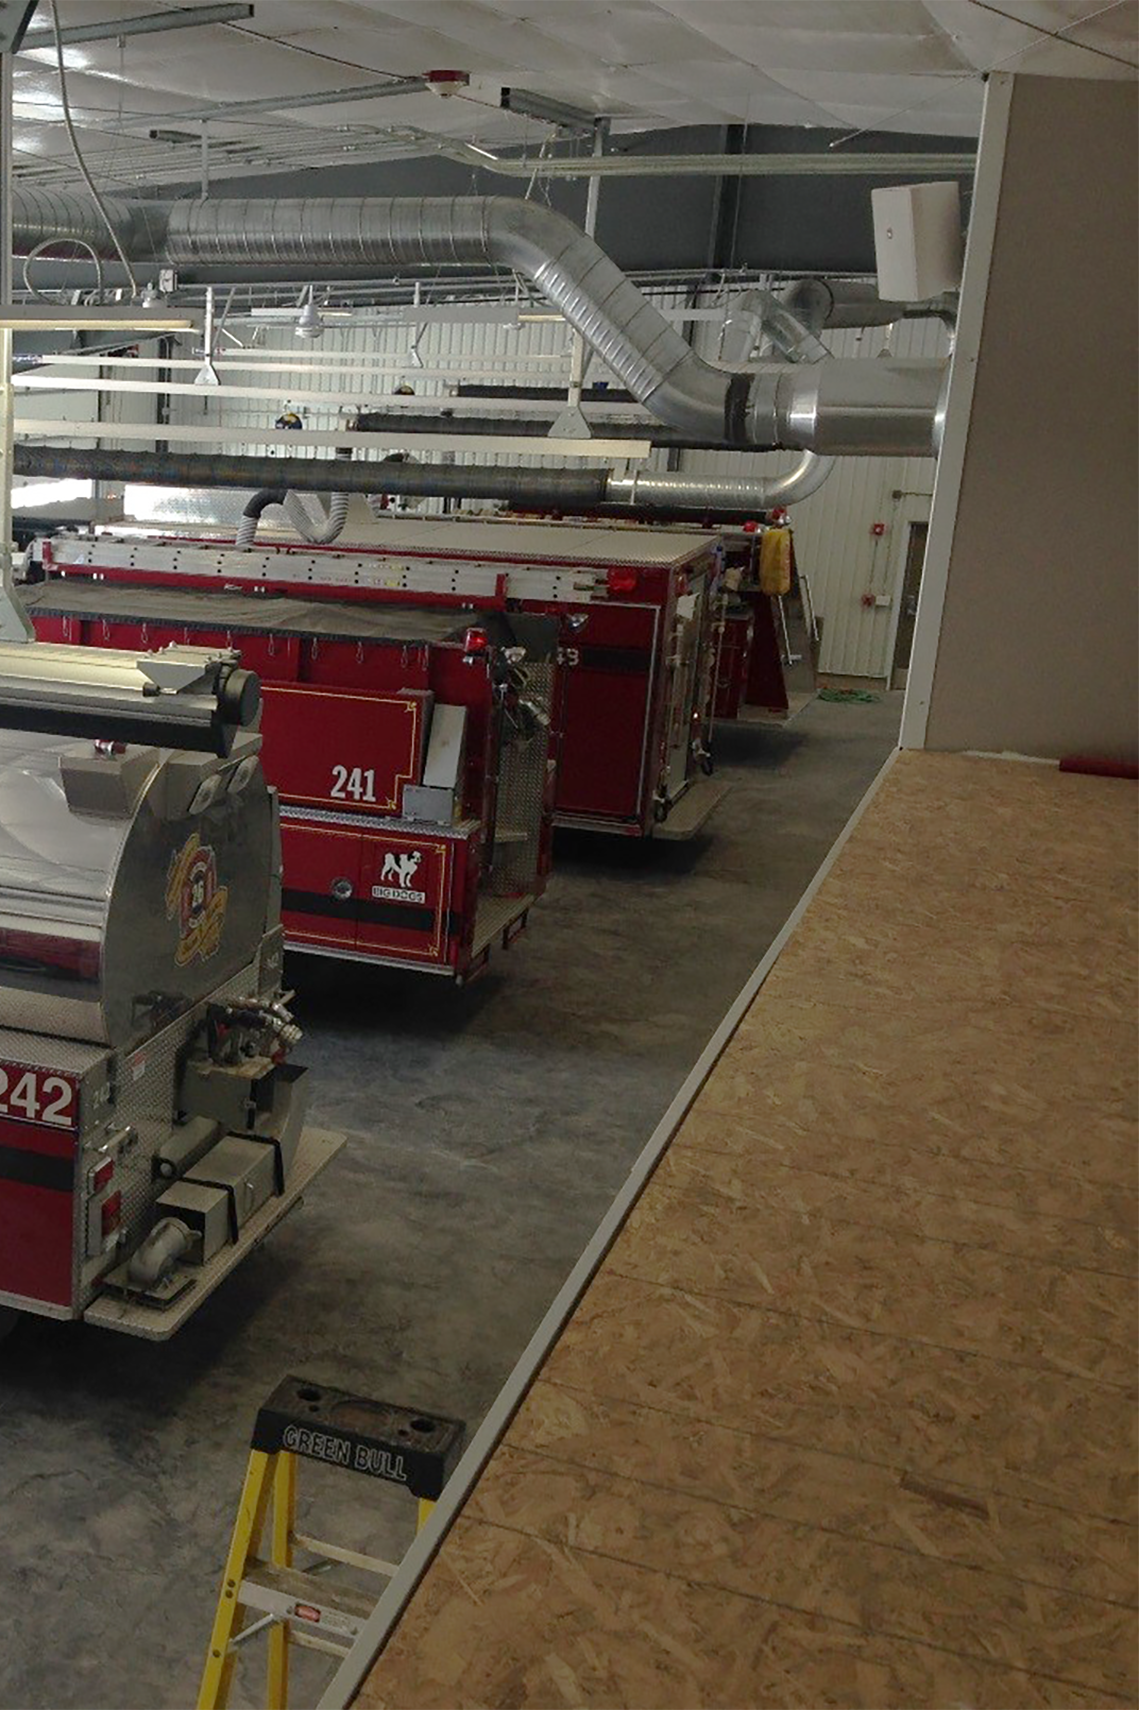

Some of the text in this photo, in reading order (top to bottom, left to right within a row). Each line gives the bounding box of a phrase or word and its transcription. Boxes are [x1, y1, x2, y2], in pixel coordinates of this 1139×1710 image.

[330, 764, 377, 803] 241
[283, 1424, 408, 1482] GREEN BULL
